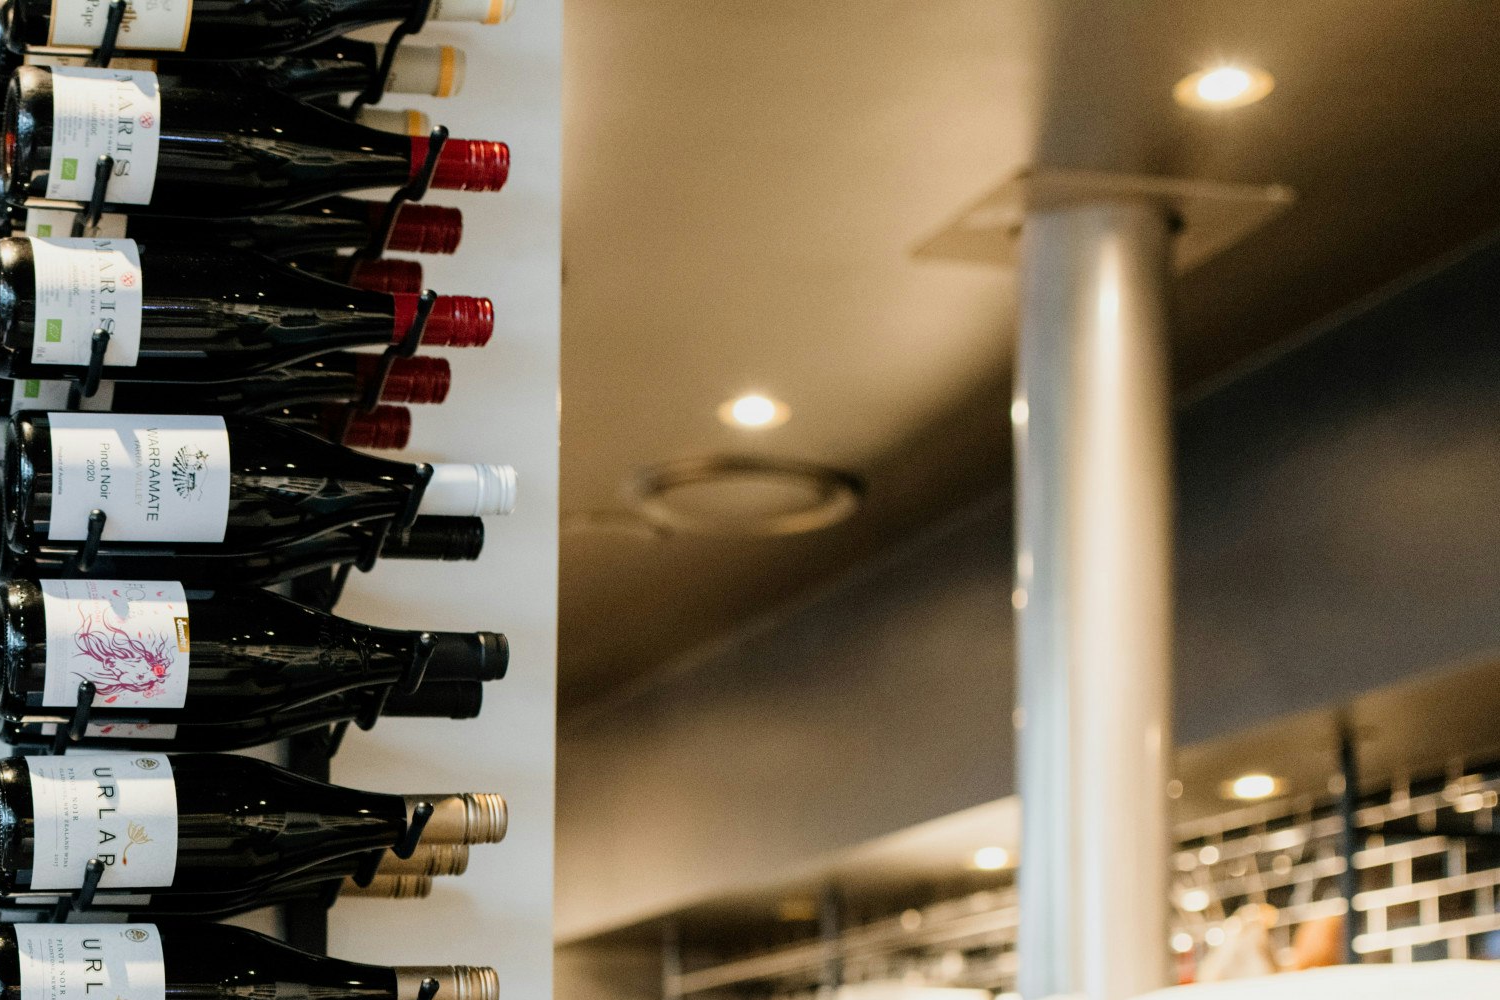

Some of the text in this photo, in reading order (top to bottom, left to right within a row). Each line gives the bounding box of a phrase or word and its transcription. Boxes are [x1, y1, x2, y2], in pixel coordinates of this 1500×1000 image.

[114, 74, 135, 177] MARIS
[92, 239, 116, 335] MARIS
[86, 459, 96, 482] 2020
[100, 443, 111, 500] Pinot Noir
[133, 440, 143, 506] YARRA VALLEY
[146, 427, 161, 521] WARRAMATE
[93, 767, 116, 867] URLAR
[56, 939, 65, 964] PINOT
